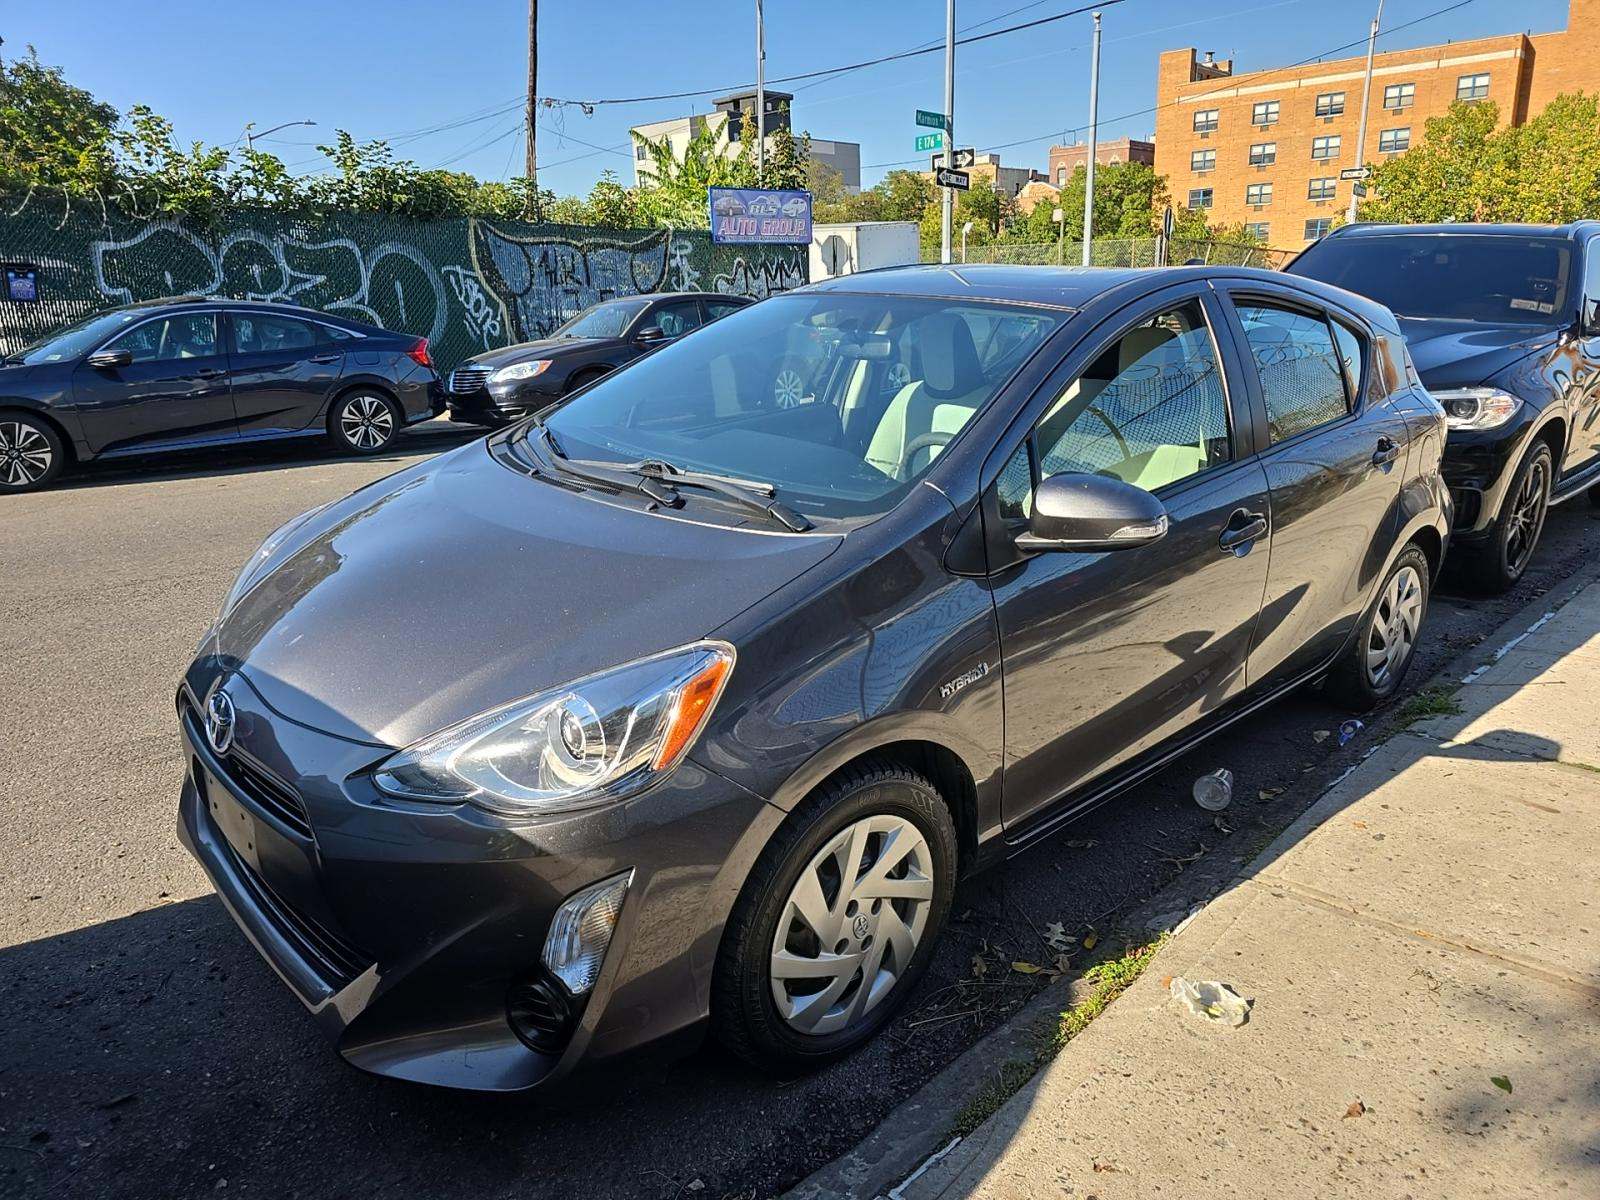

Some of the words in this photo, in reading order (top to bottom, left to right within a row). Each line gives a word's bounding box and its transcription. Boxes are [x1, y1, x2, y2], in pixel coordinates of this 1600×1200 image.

[918, 140, 923, 150] E
[923, 136, 935, 149] 176
[717, 217, 758, 236] AUTO
[760, 218, 806, 237] GROUP
[939, 662, 989, 698] HYBRID
